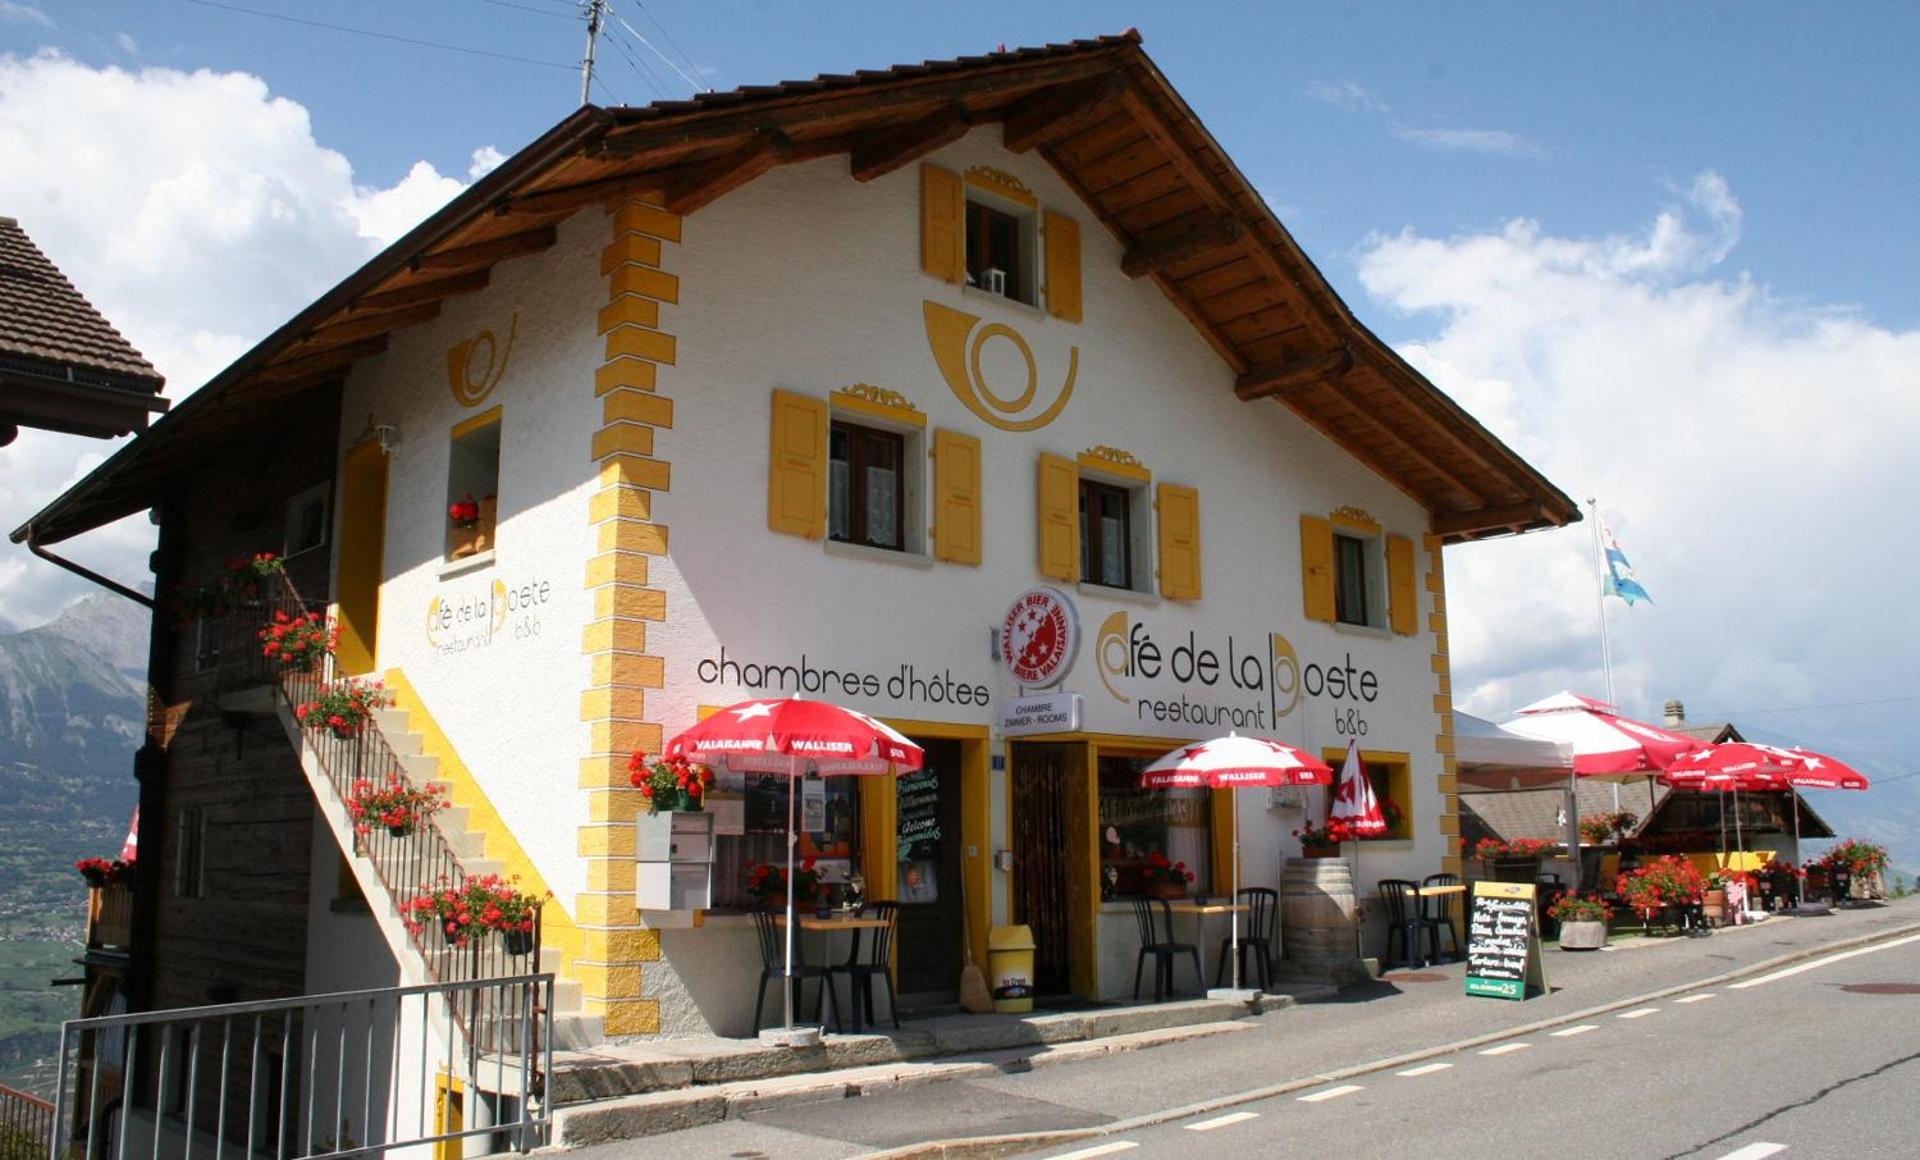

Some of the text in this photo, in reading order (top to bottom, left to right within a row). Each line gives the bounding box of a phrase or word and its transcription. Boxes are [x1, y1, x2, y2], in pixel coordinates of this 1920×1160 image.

[489, 577, 551, 644] poste
[1003, 595, 1049, 665] WALLISER BIER
[697, 646, 990, 706] chambres d'hôtes
[1171, 630, 1219, 686] de
[1229, 636, 1264, 691] la
[1268, 632, 1378, 730] poste
[1004, 716, 1033, 728] ZIMMER
[1037, 712, 1067, 725] ROOMS
[1015, 702, 1053, 715] CHAMBRE
[1138, 693, 1368, 736] restaurant b&b
[695, 739, 763, 751] VALAISANNE
[791, 740, 853, 752] WALLISER
[1218, 772, 1266, 782] WALLISER
